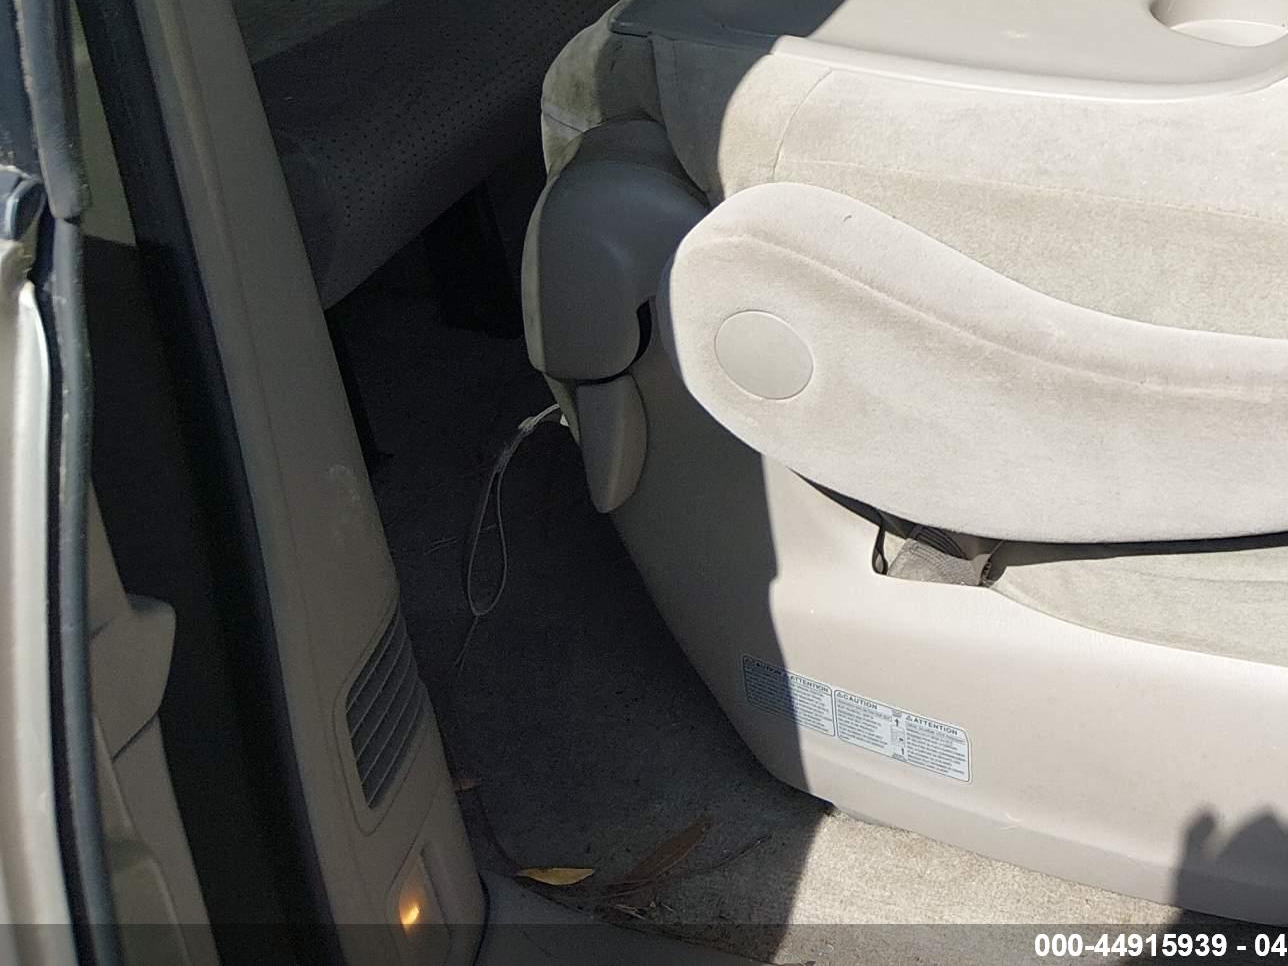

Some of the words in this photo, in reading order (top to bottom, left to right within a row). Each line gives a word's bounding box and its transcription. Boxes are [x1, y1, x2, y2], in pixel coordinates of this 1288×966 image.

[790, 675, 829, 692] ATTENTION
[844, 694, 878, 710] CAUTION
[914, 716, 958, 736] ATTENTION
